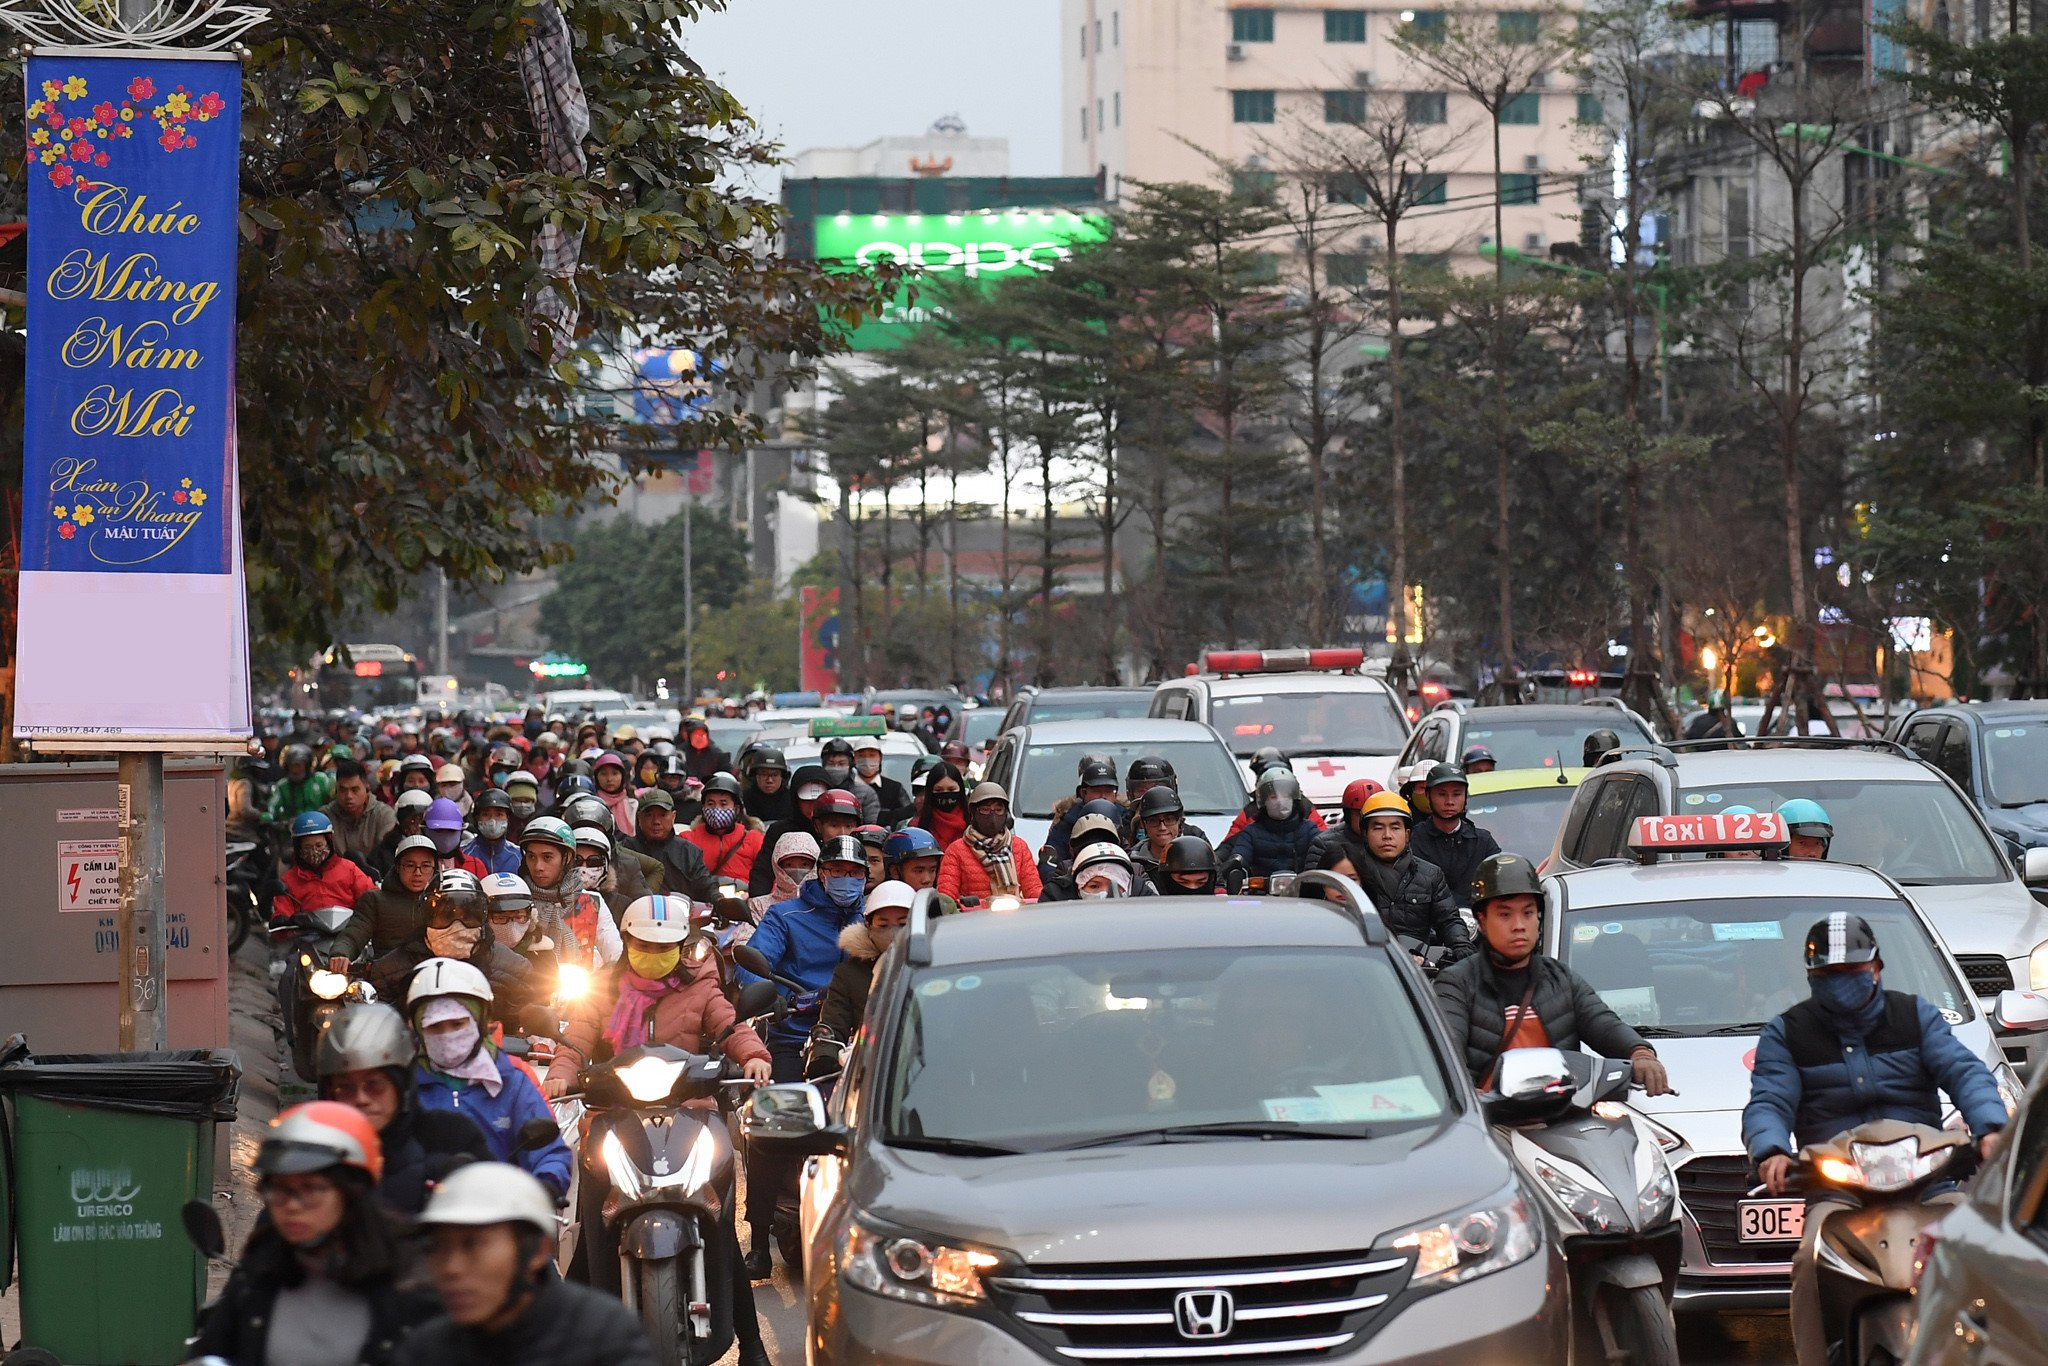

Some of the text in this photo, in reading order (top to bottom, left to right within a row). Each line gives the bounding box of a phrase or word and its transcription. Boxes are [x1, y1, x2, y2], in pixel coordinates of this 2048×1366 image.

[74, 180, 201, 235] Chúc
[46, 249, 221, 325] Mừng
[61, 316, 205, 370] Năm
[70, 384, 196, 437] Mới
[50, 457, 119, 492] Xuân
[89, 480, 203, 565] Khang
[105, 524, 178, 541] MẬU TUẤT
[1642, 813, 1777, 842] Taxi 123
[83, 860, 117, 872] CẤM LẠI
[77, 1204, 133, 1217] URENCO
[1745, 1207, 1806, 1235] 30E-
